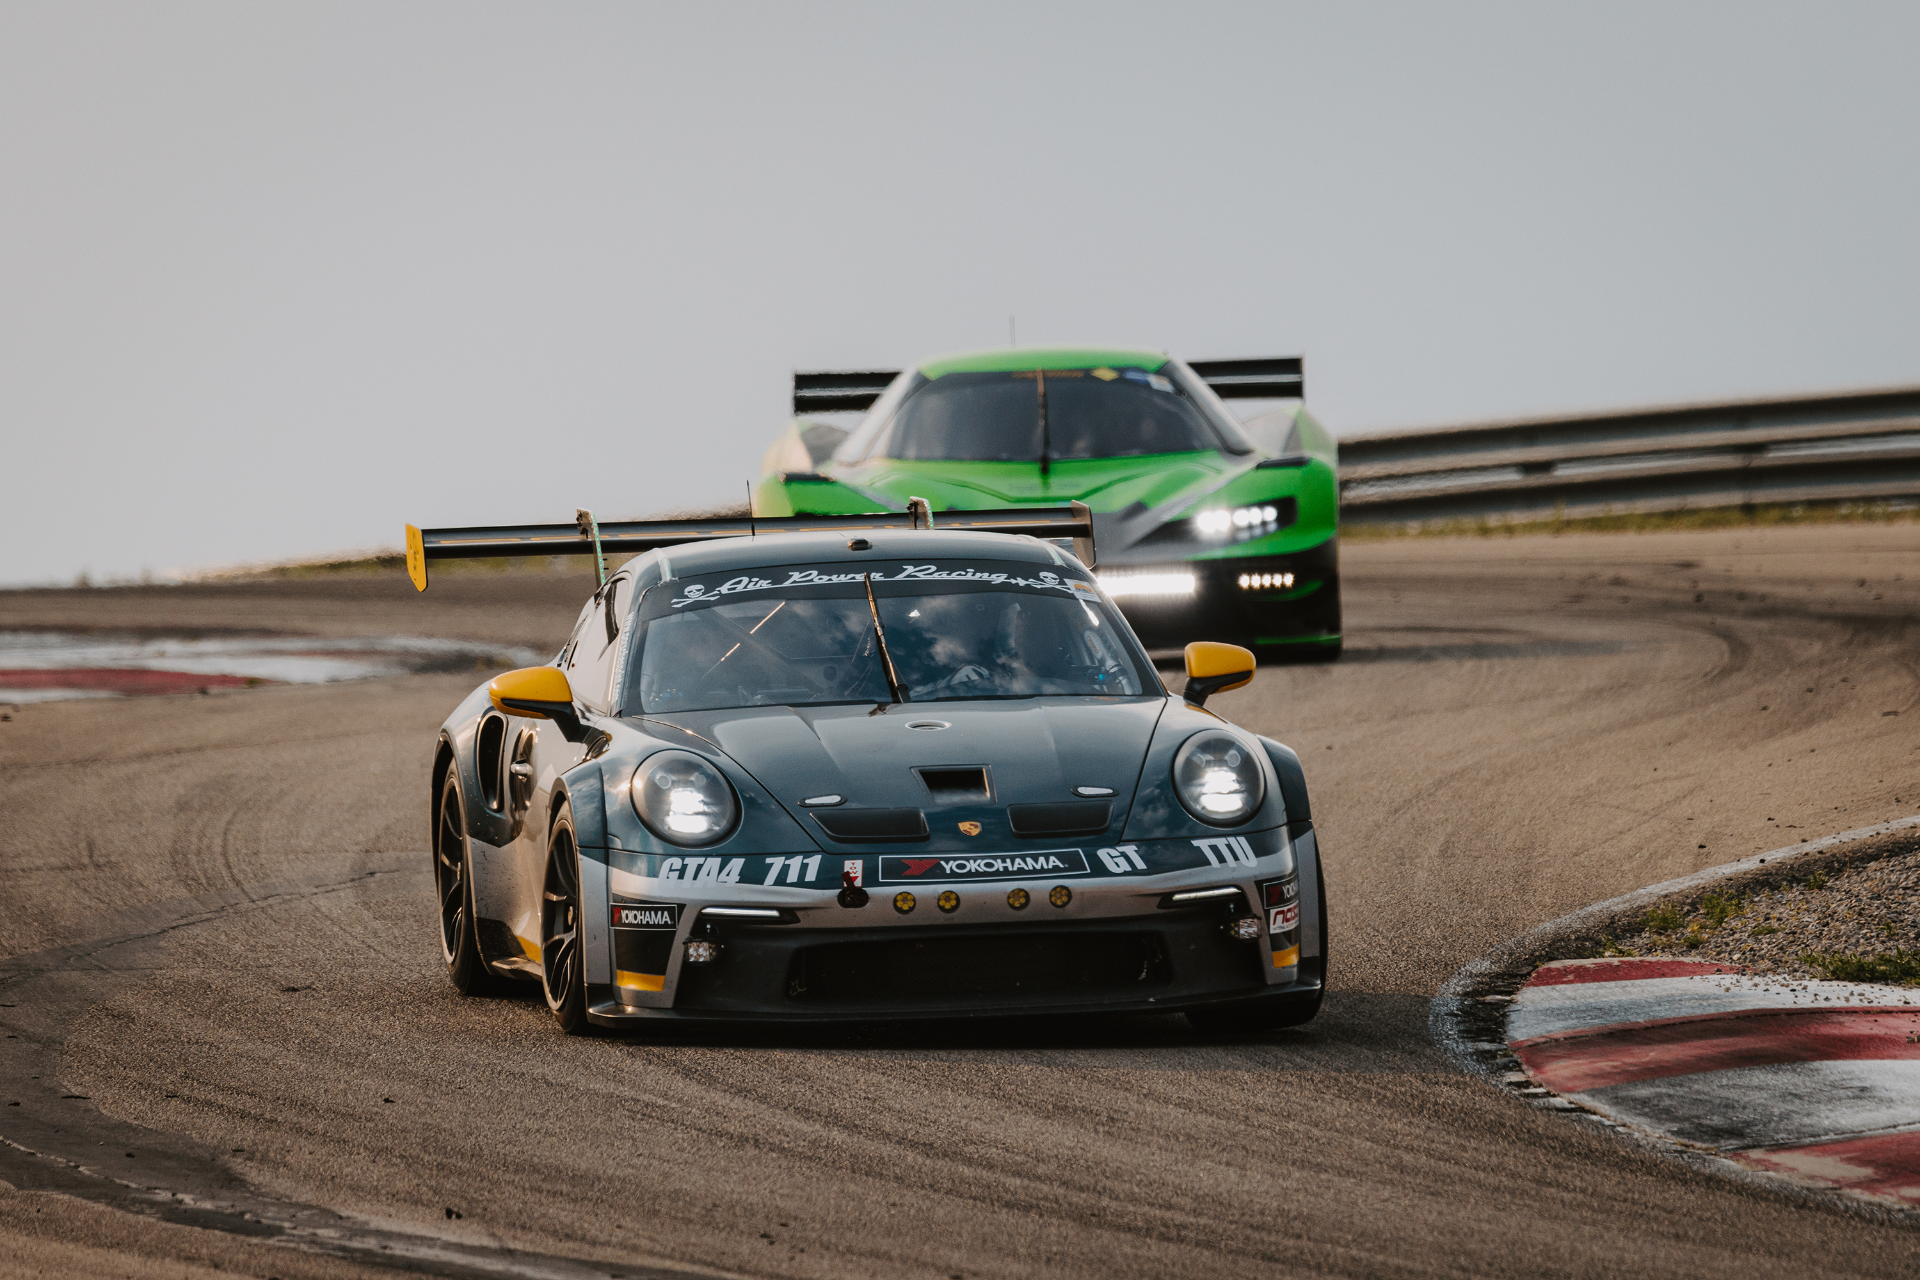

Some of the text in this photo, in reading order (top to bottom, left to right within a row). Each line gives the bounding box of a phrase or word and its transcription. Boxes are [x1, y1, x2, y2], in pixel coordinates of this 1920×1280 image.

[715, 564, 1009, 594] Air Power Racing
[940, 856, 1065, 873] YOKOHAMA
[1096, 845, 1148, 873] GT
[1191, 836, 1258, 868] TTU
[658, 854, 822, 889] GTA4 711
[848, 862, 859, 875] TOW
[620, 909, 671, 924] YOKOHAMA
